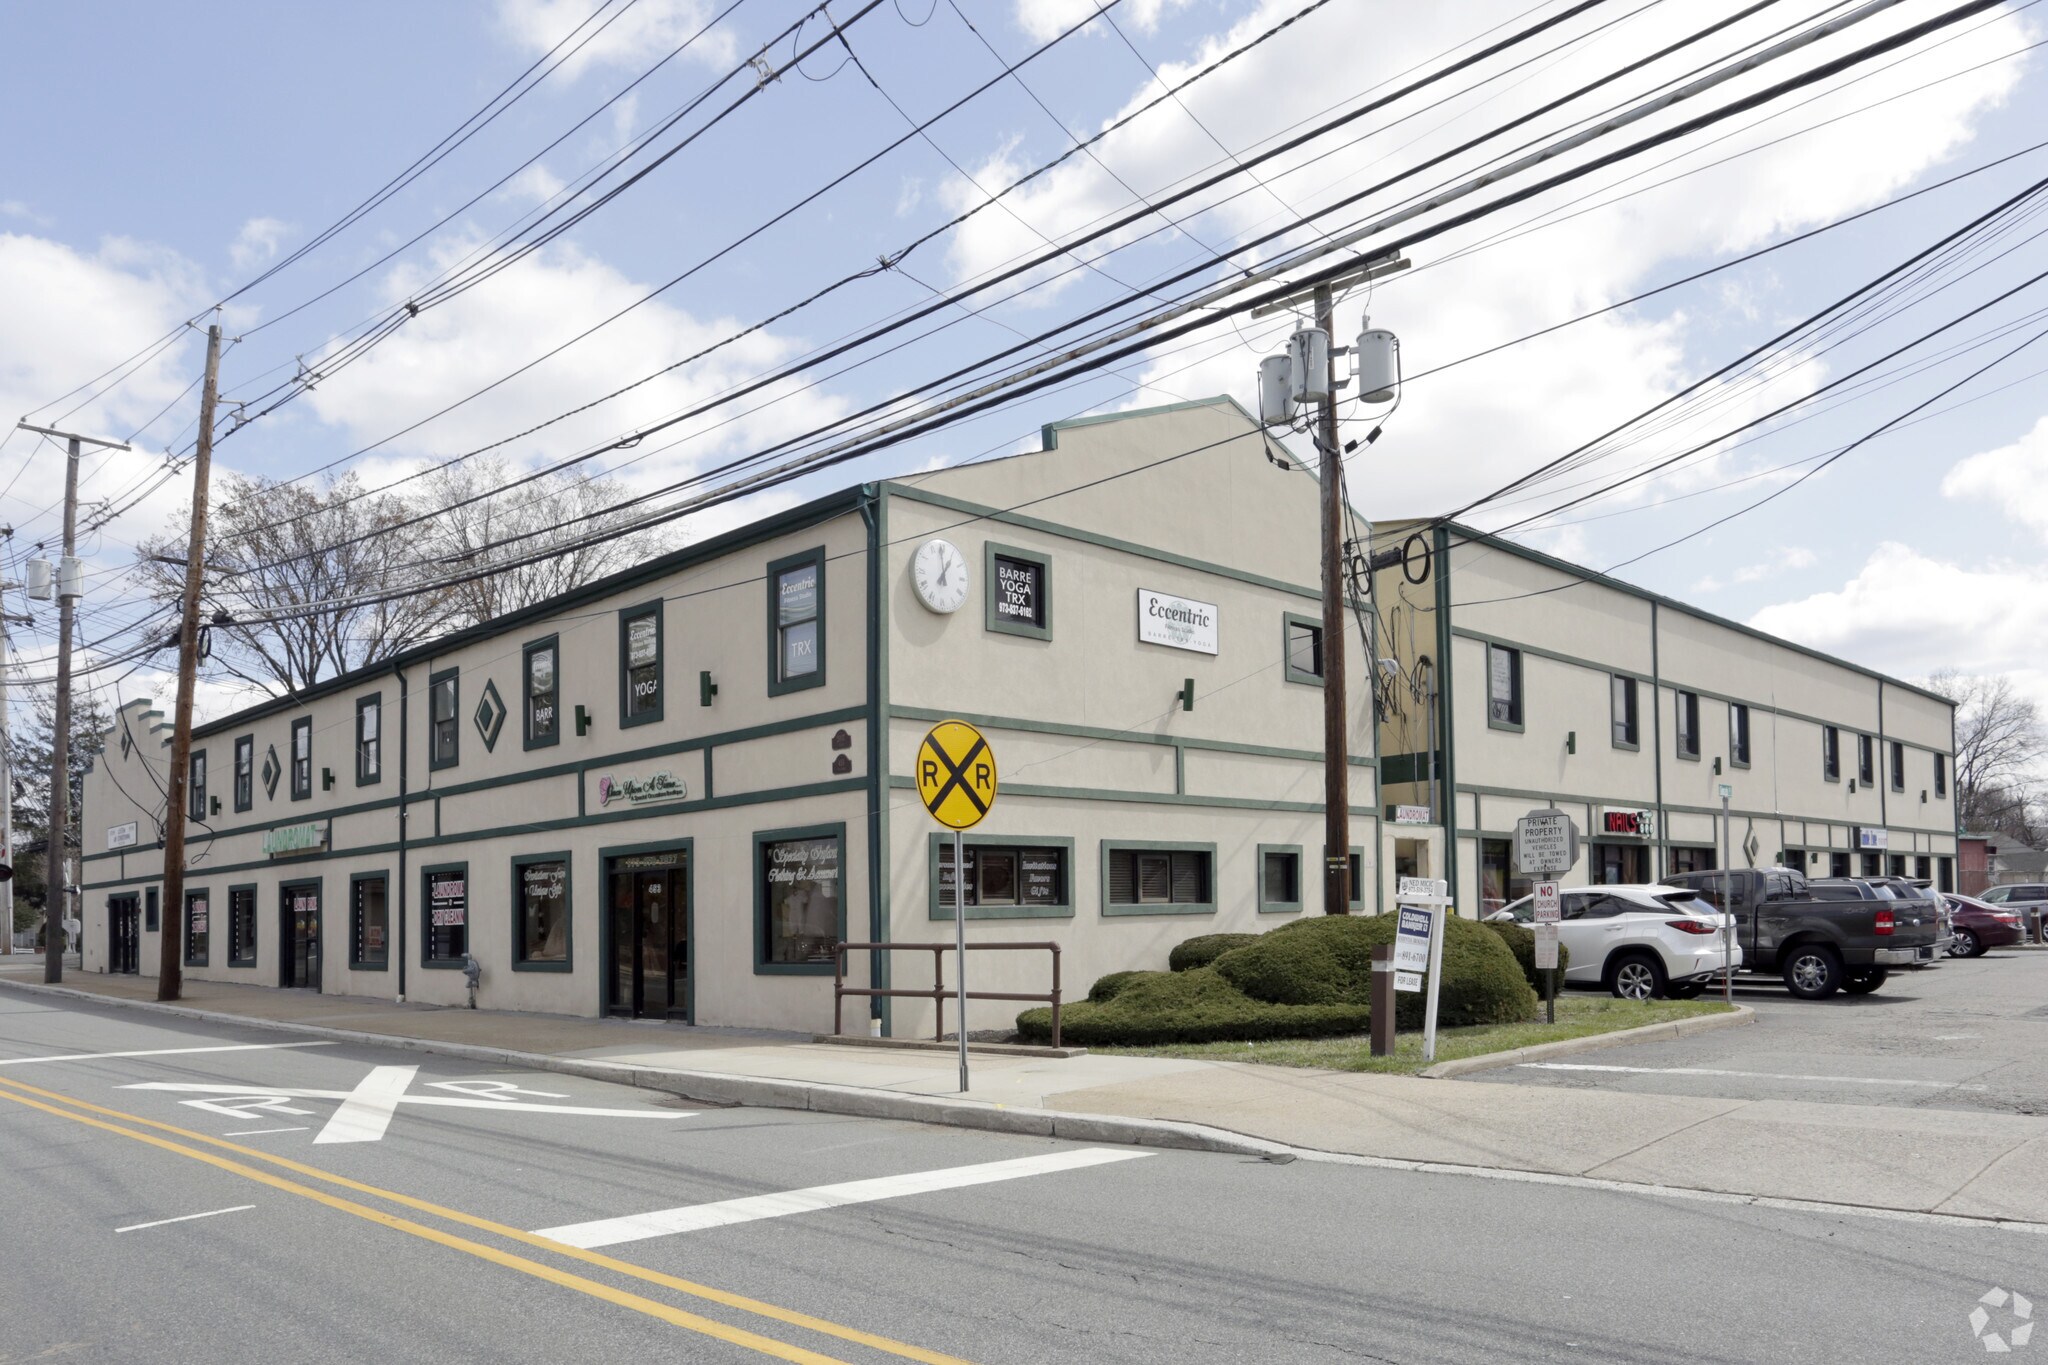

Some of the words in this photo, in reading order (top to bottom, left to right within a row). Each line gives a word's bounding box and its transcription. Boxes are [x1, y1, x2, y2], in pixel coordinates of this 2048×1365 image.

[1000, 567, 1031, 583] BARRE
[781, 576, 815, 595] Eccentric
[1000, 579, 1031, 595] YOGA
[1005, 591, 1025, 605] TRX
[1149, 597, 1209, 627] Eccentric
[792, 640, 812, 656] TRX
[923, 760, 938, 787] R
[976, 763, 990, 789] R
[623, 780, 642, 799] Upon
[643, 776, 655, 792] A
[1397, 809, 1429, 820] LAUNDROMAT
[1528, 817, 1557, 826] PRIVATE
[1610, 812, 1637, 832] NAILS
[1525, 827, 1562, 836] PROPERTY
[263, 824, 316, 853] LAUNDROMAT
[1525, 836, 1563, 844] UNAUTHORIZED
[796, 866, 807, 880] &
[1541, 886, 1553, 897] NO
[1537, 900, 1558, 908] CHURCH
[1402, 912, 1429, 924] COLDWELL
[1536, 910, 1558, 919] PARKING
[1401, 920, 1423, 931] BANKER
[1401, 951, 1426, 963] 891-6700
[1398, 975, 1406, 985] FOR
[1406, 976, 1419, 987] LEASE
